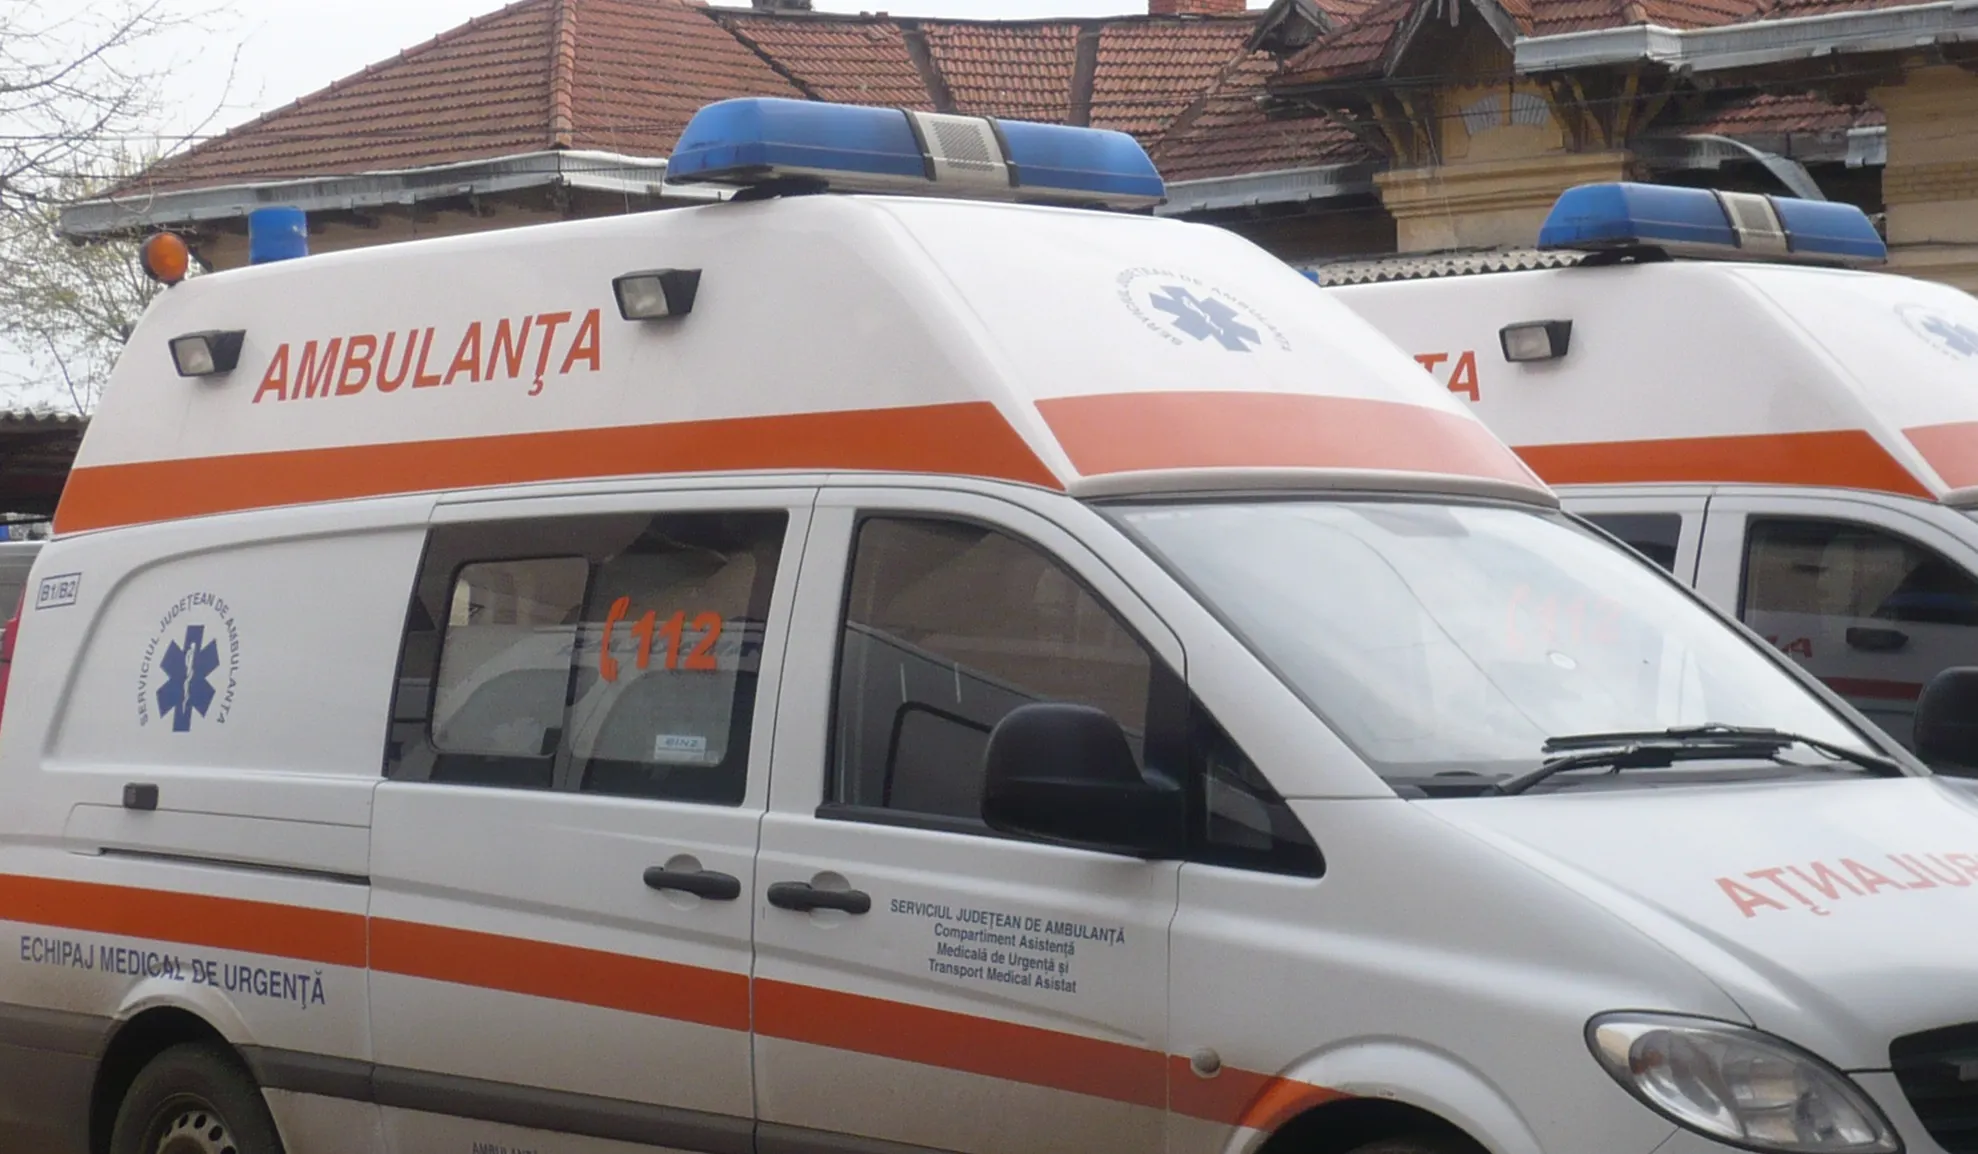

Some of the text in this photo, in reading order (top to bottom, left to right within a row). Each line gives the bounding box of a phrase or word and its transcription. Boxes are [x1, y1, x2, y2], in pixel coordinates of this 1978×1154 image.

[630, 609, 723, 670] 112
[136, 636, 160, 727] SERVICIUL
[214, 597, 230, 620] DE
[890, 898, 953, 920] SERVICIUL
[1025, 917, 1041, 933] DE
[934, 922, 1016, 948] Compartiment
[20, 935, 95, 970] ECHIPAJ
[99, 945, 186, 981] MEDICAL
[191, 959, 221, 987] DE
[928, 958, 1077, 994] Transport Medical Asistat
[990, 951, 1005, 965] de
